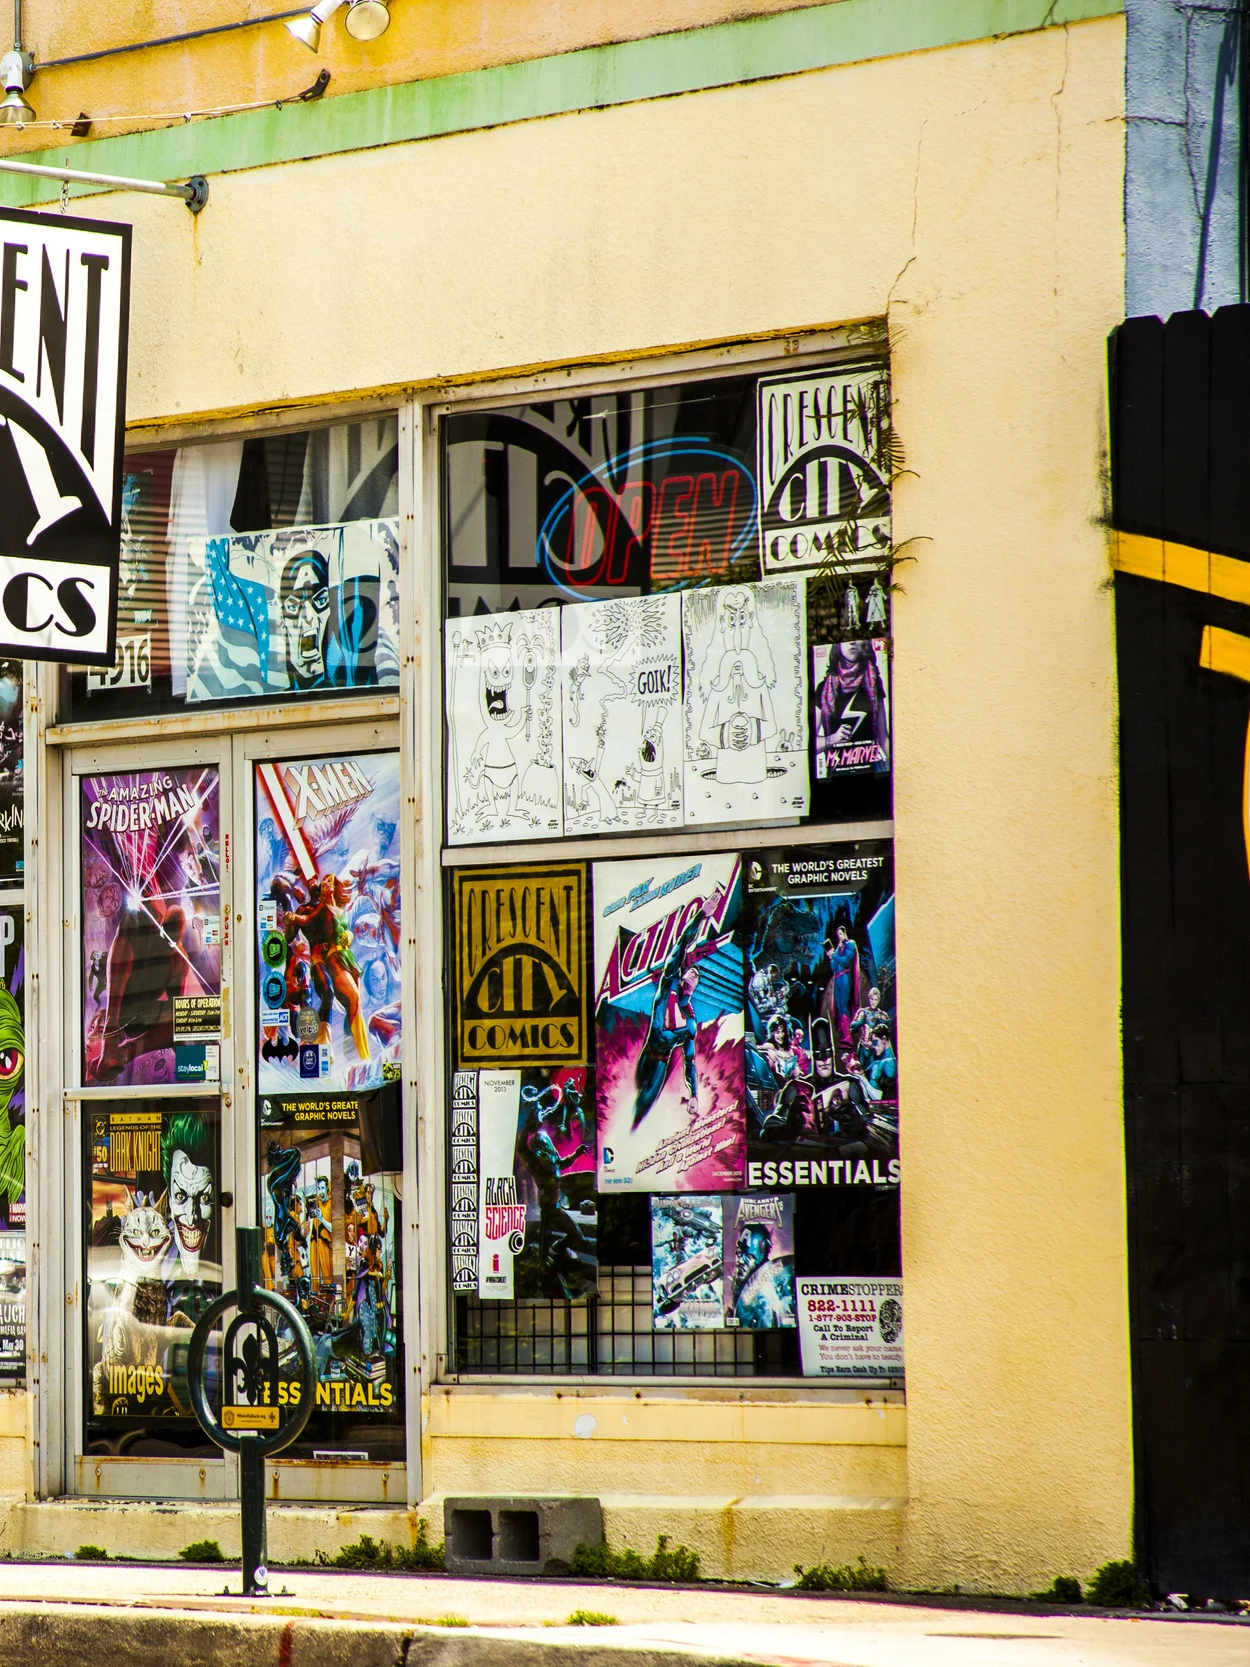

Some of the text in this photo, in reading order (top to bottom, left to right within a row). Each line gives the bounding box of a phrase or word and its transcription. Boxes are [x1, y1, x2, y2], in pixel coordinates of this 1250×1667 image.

[779, 457, 879, 522] CITY
[566, 469, 739, 586] OPEN
[637, 664, 672, 694] GOIK!
[108, 776, 172, 801] AMAZING
[284, 761, 374, 831] X-MEN
[86, 783, 196, 832] SPIDER-MAN
[772, 857, 884, 874] THE WORLD'S GREATEST
[787, 869, 868, 885] GRAPHIC NOVELS
[658, 863, 702, 899] KUDER
[467, 886, 573, 978] CRESCENT
[595, 851, 742, 1011] ACTION
[477, 954, 568, 1013] CITY
[191, 998, 197, 1009] OF
[299, 1024, 312, 1035] yelp
[468, 1022, 575, 1051] COMICS
[282, 1101, 358, 1111] THE WORLD'S GREATE
[295, 1111, 355, 1121] GRAPHIC NOVELS
[110, 1131, 161, 1172] DARK KNIGHT
[748, 1159, 900, 1186] ESSENTIALS
[486, 1177, 517, 1205] BLACK
[485, 1205, 525, 1240] SCIENCE
[801, 1284, 903, 1296] CRIMESTOPPER
[807, 1300, 876, 1312] 822-1111
[846, 1325, 874, 1333] Report
[15, 1339, 24, 1350] 30
[865, 1346, 882, 1354] your
[109, 1362, 163, 1403] images
[820, 1366, 834, 1375] Tips
[868, 1366, 878, 1375] Up
[263, 1382, 393, 1405] ESSNTIALS
